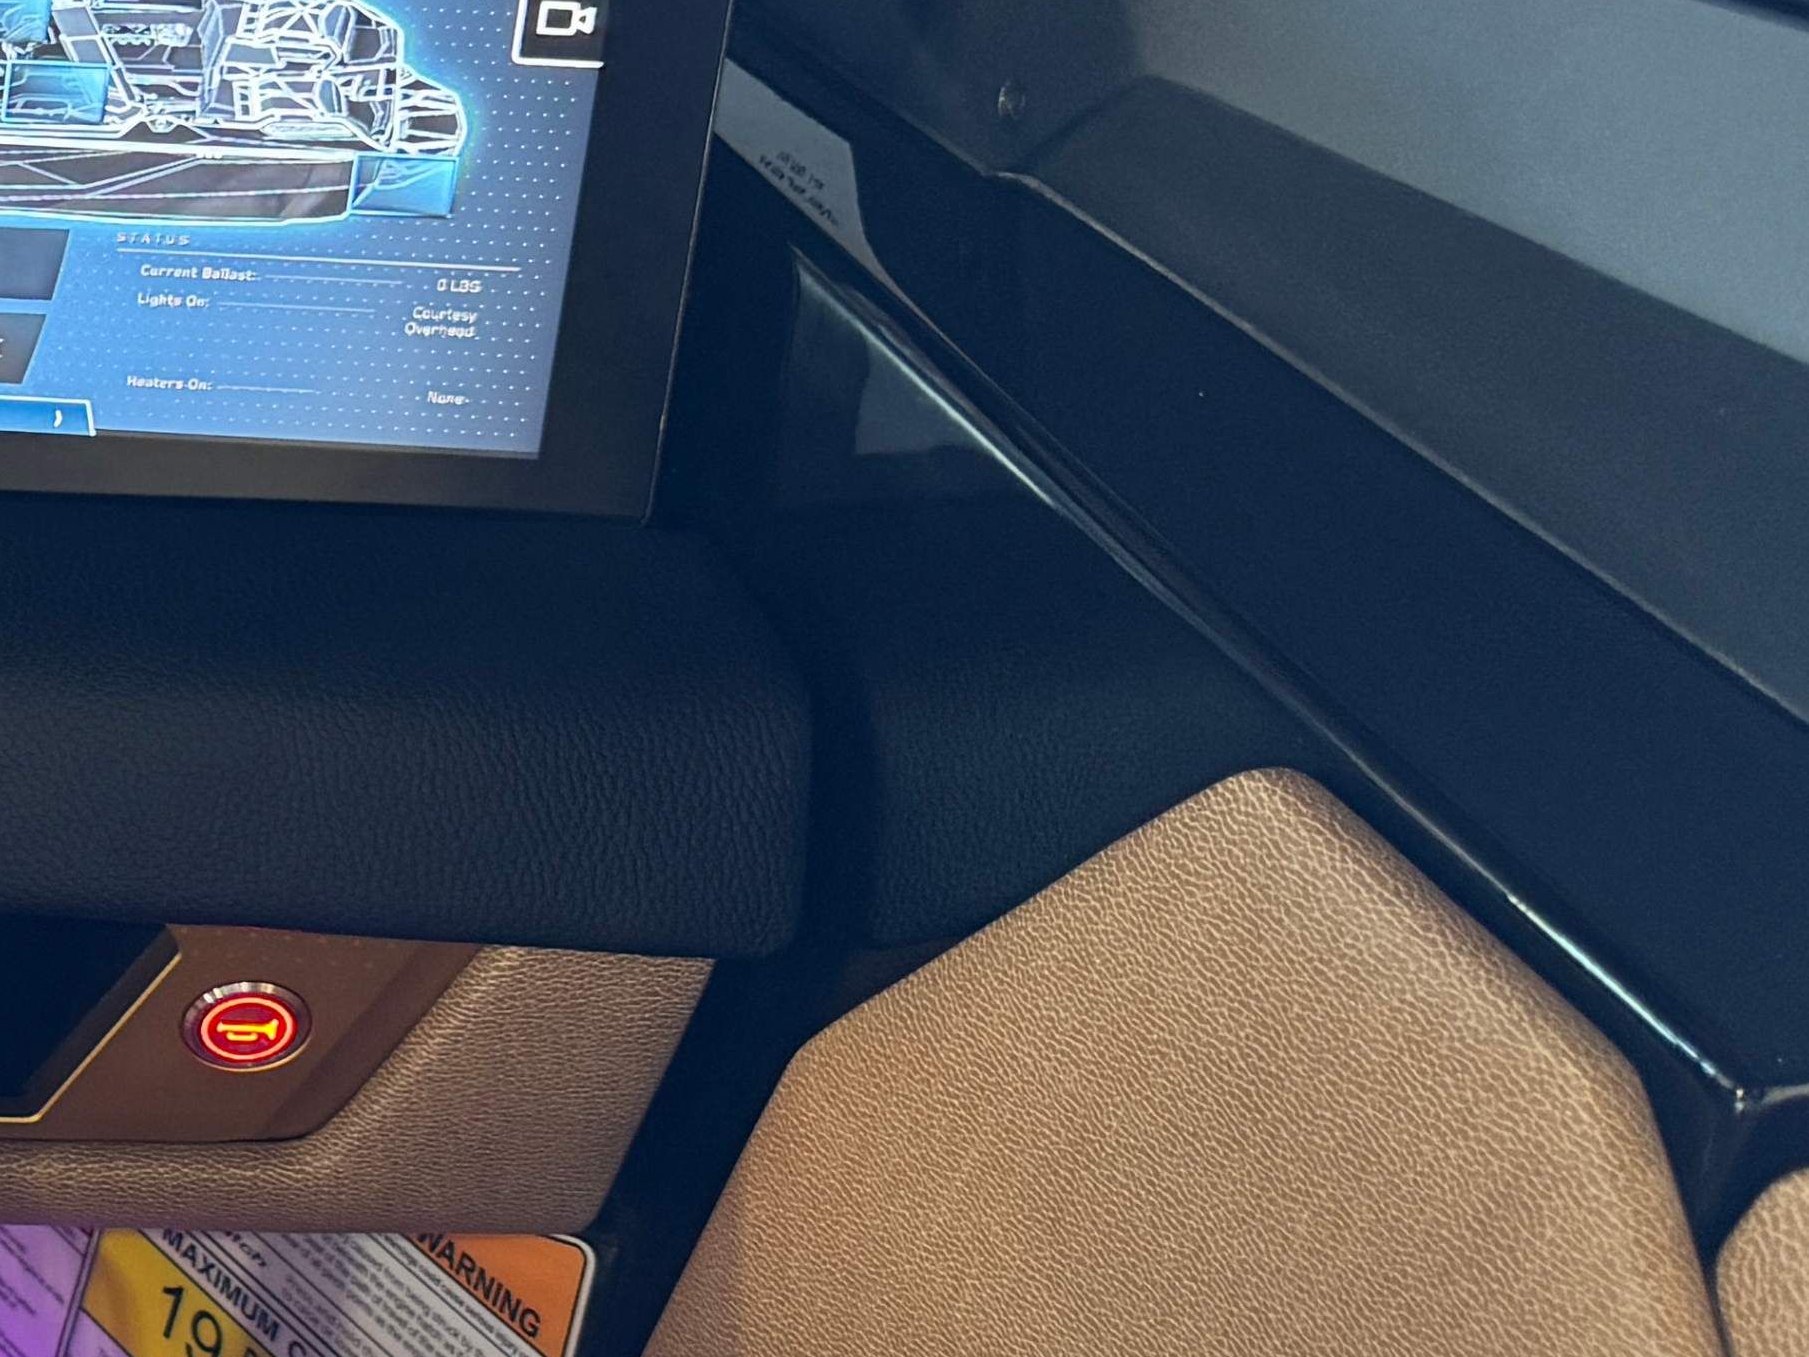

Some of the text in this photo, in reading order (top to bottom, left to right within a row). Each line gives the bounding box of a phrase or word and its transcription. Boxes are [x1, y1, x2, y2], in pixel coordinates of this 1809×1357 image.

[116, 232, 190, 245] STATUS
[140, 264, 257, 281] Current Ballast:
[450, 279, 482, 292] LBS
[137, 293, 210, 309] Lights On:
[412, 306, 477, 323] Courtesy
[404, 322, 477, 338] Overhead
[127, 375, 212, 391] Heaters On:
[427, 391, 465, 405] None
[163, 1228, 280, 1341] MAXIMUM
